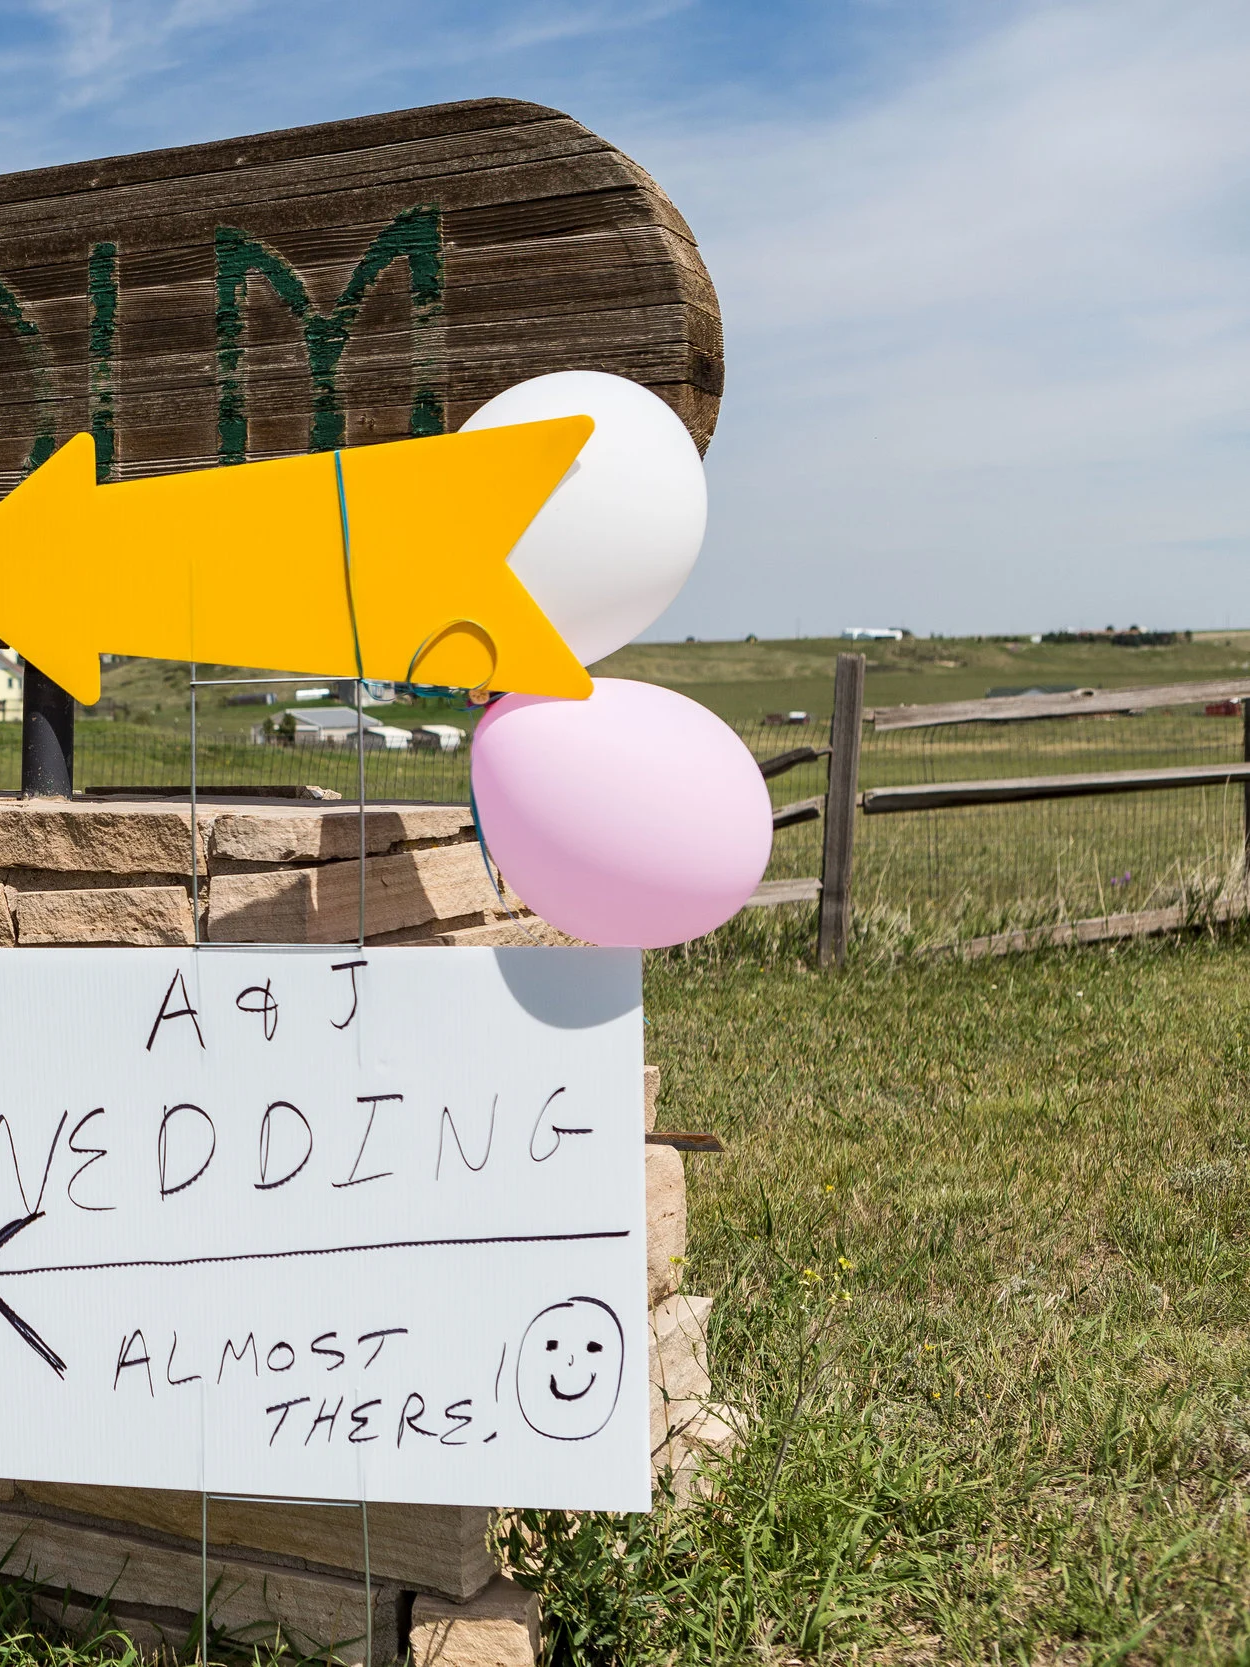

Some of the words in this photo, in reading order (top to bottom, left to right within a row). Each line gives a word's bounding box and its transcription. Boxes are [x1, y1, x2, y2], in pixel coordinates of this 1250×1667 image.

[146, 968, 206, 1051] A
[329, 960, 368, 1030] J
[113, 1328, 409, 1397] ALMOST
[265, 1342, 507, 1447] THERE!
